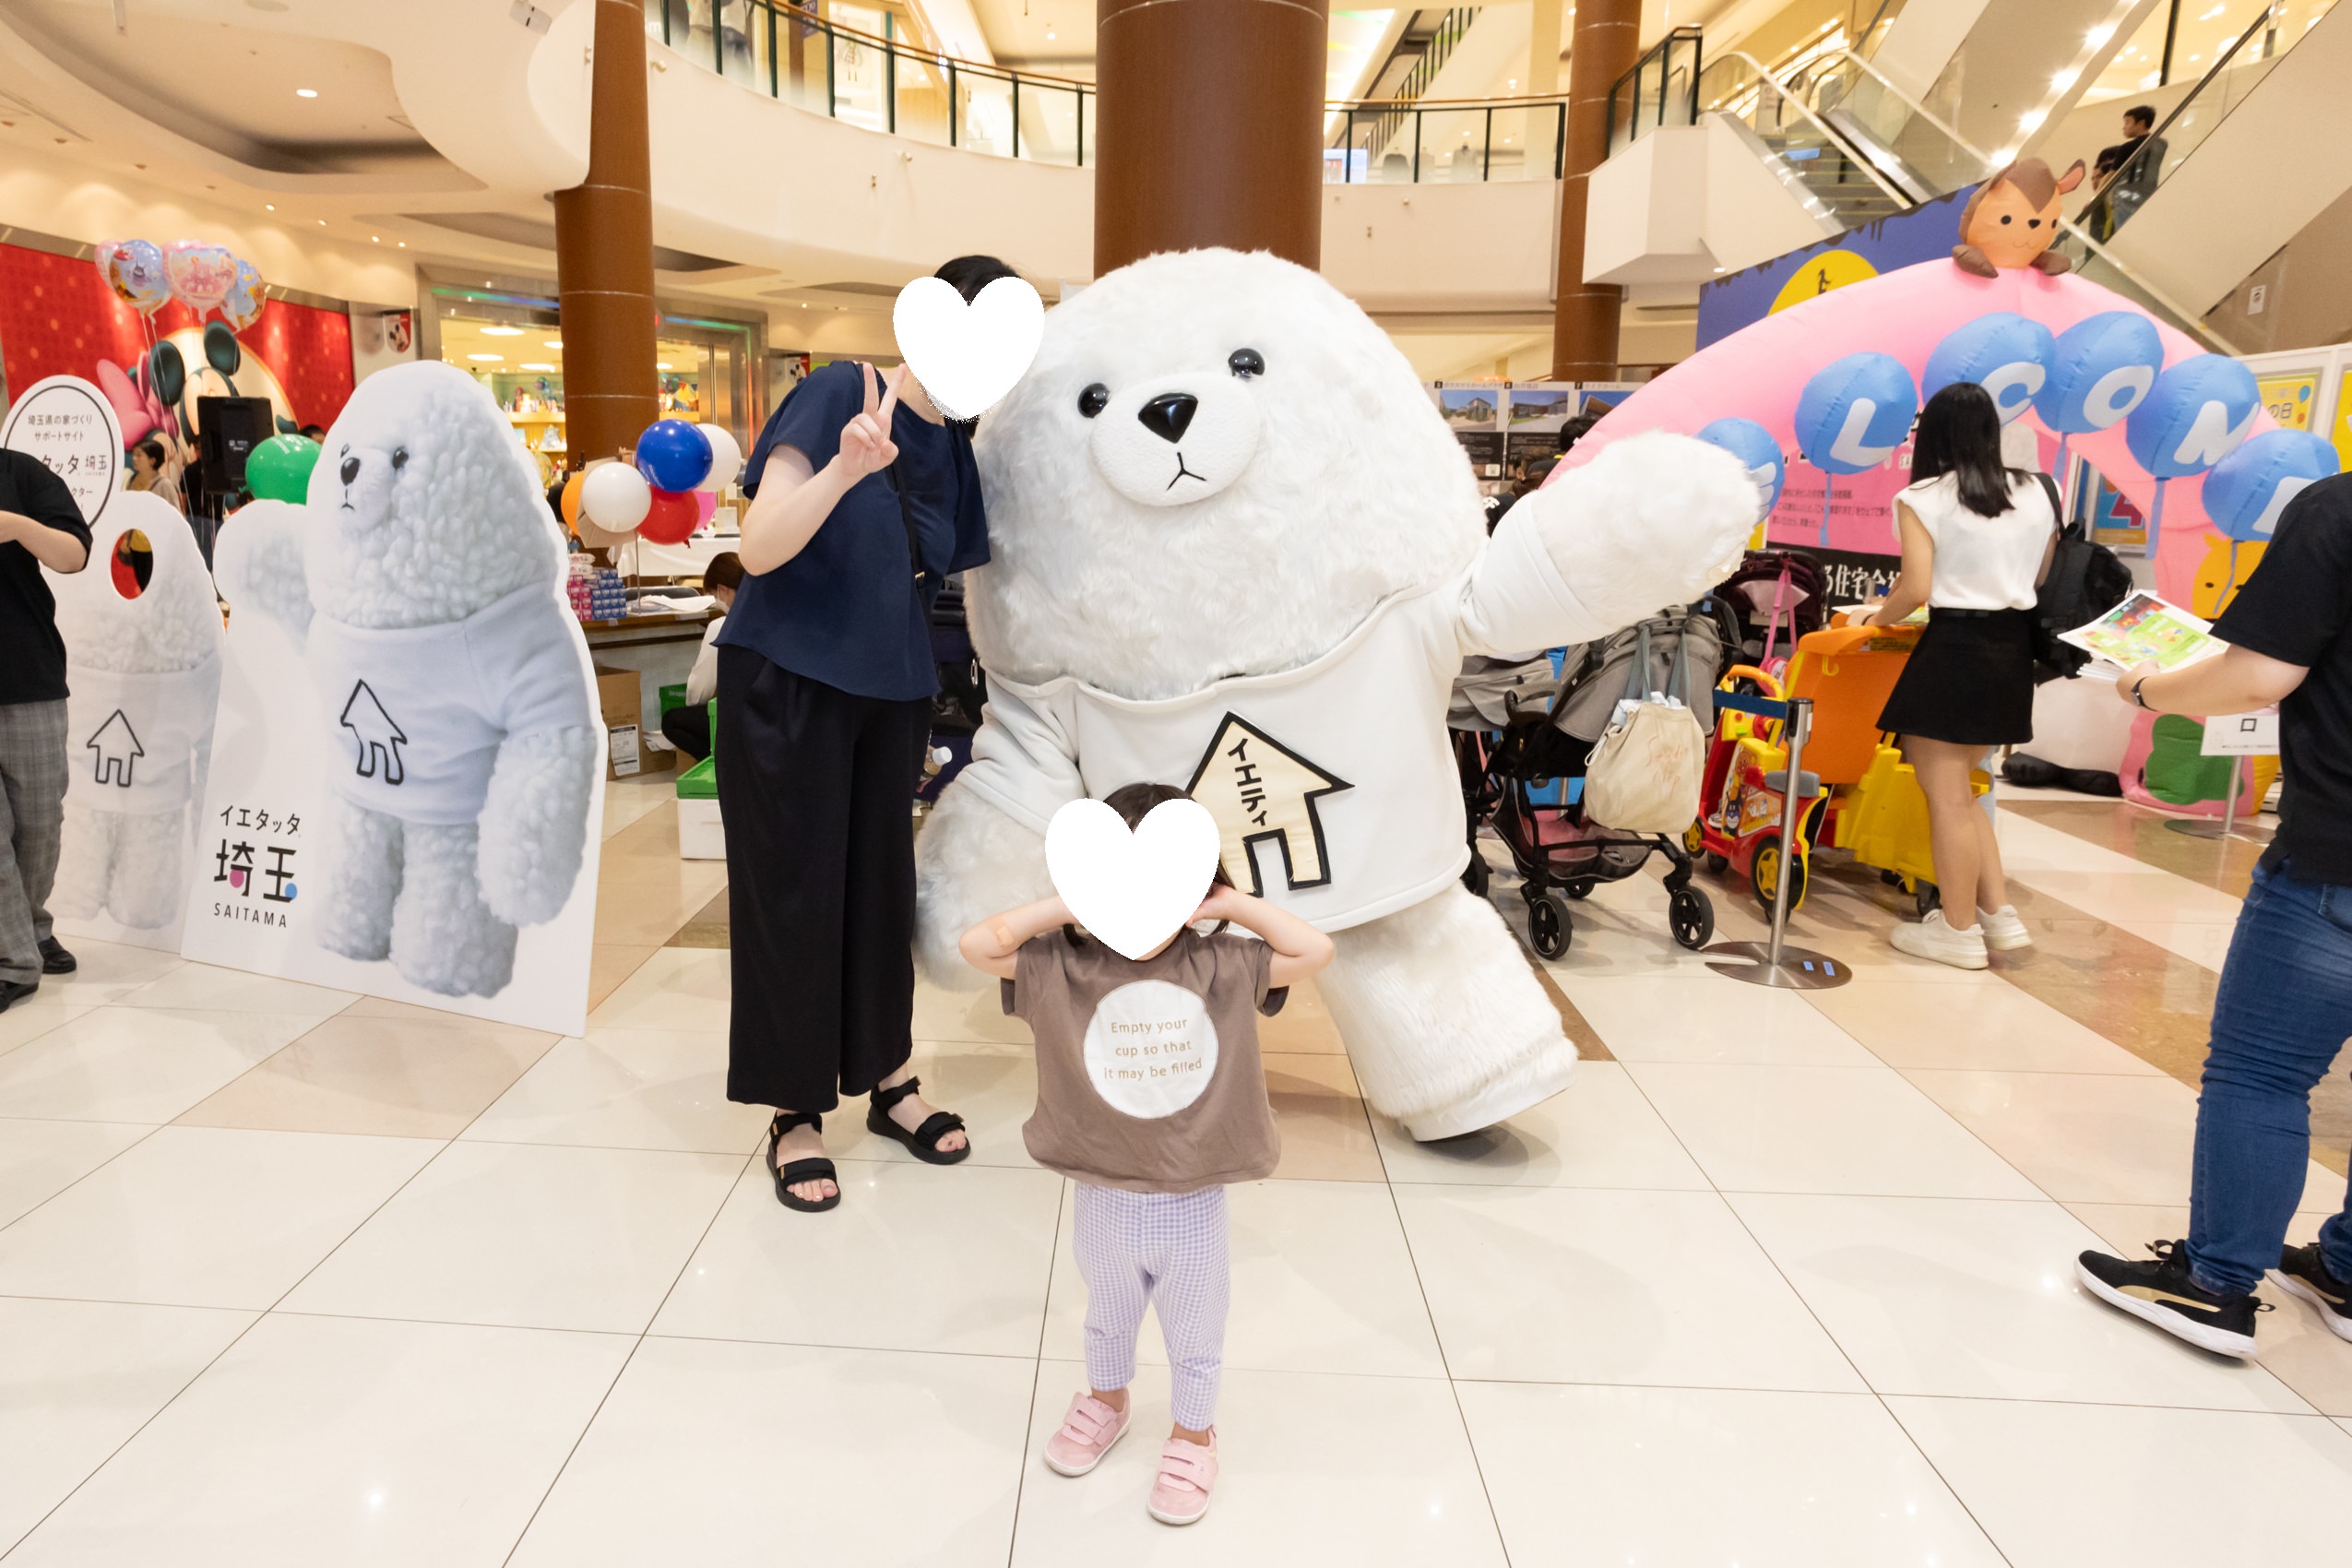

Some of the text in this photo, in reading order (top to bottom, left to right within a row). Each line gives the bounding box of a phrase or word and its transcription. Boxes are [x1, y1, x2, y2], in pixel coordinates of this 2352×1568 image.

[28, 414, 93, 426] 埼玉県の家づくり
[34, 431, 84, 442] サポートサイト
[1227, 738, 1268, 826] イエティ
[220, 805, 301, 836] イエタッタ
[214, 838, 299, 904] 埼玉
[213, 902, 287, 928] SAITAMA
[1111, 1018, 1188, 1035] Empty your
[1115, 1039, 1192, 1058] cup so that
[1104, 1057, 1203, 1081] it may be filled
